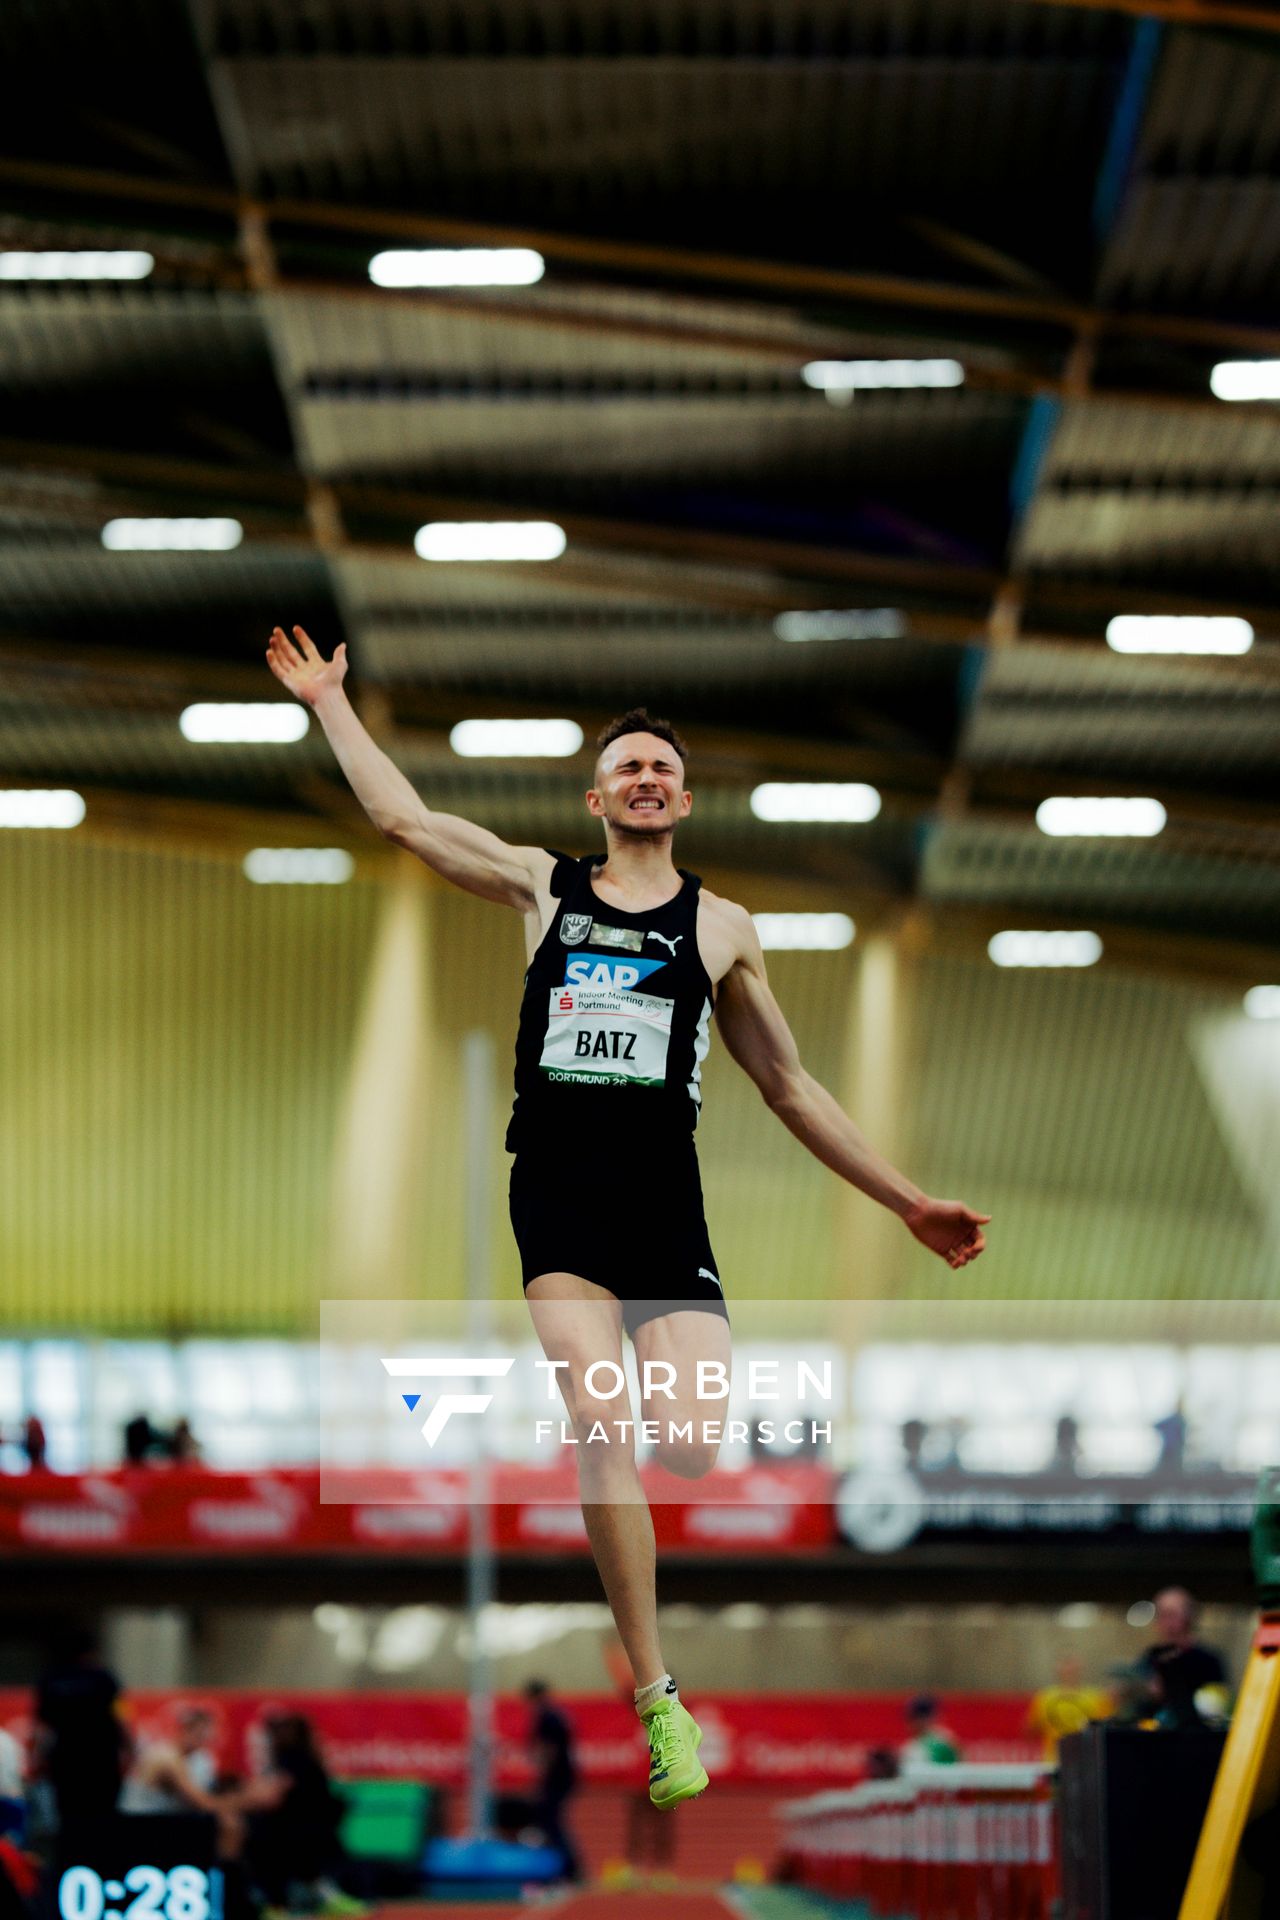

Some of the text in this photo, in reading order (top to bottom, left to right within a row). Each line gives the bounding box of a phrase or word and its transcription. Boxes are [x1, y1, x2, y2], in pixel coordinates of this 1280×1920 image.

[565, 961, 639, 990] SAP
[578, 1001, 621, 1010] Dortmund
[608, 991, 644, 1007] Meeting
[575, 1030, 638, 1060] BATZ
[548, 1071, 610, 1085] DORTMUND
[58, 1865, 210, 1920] 0:28
